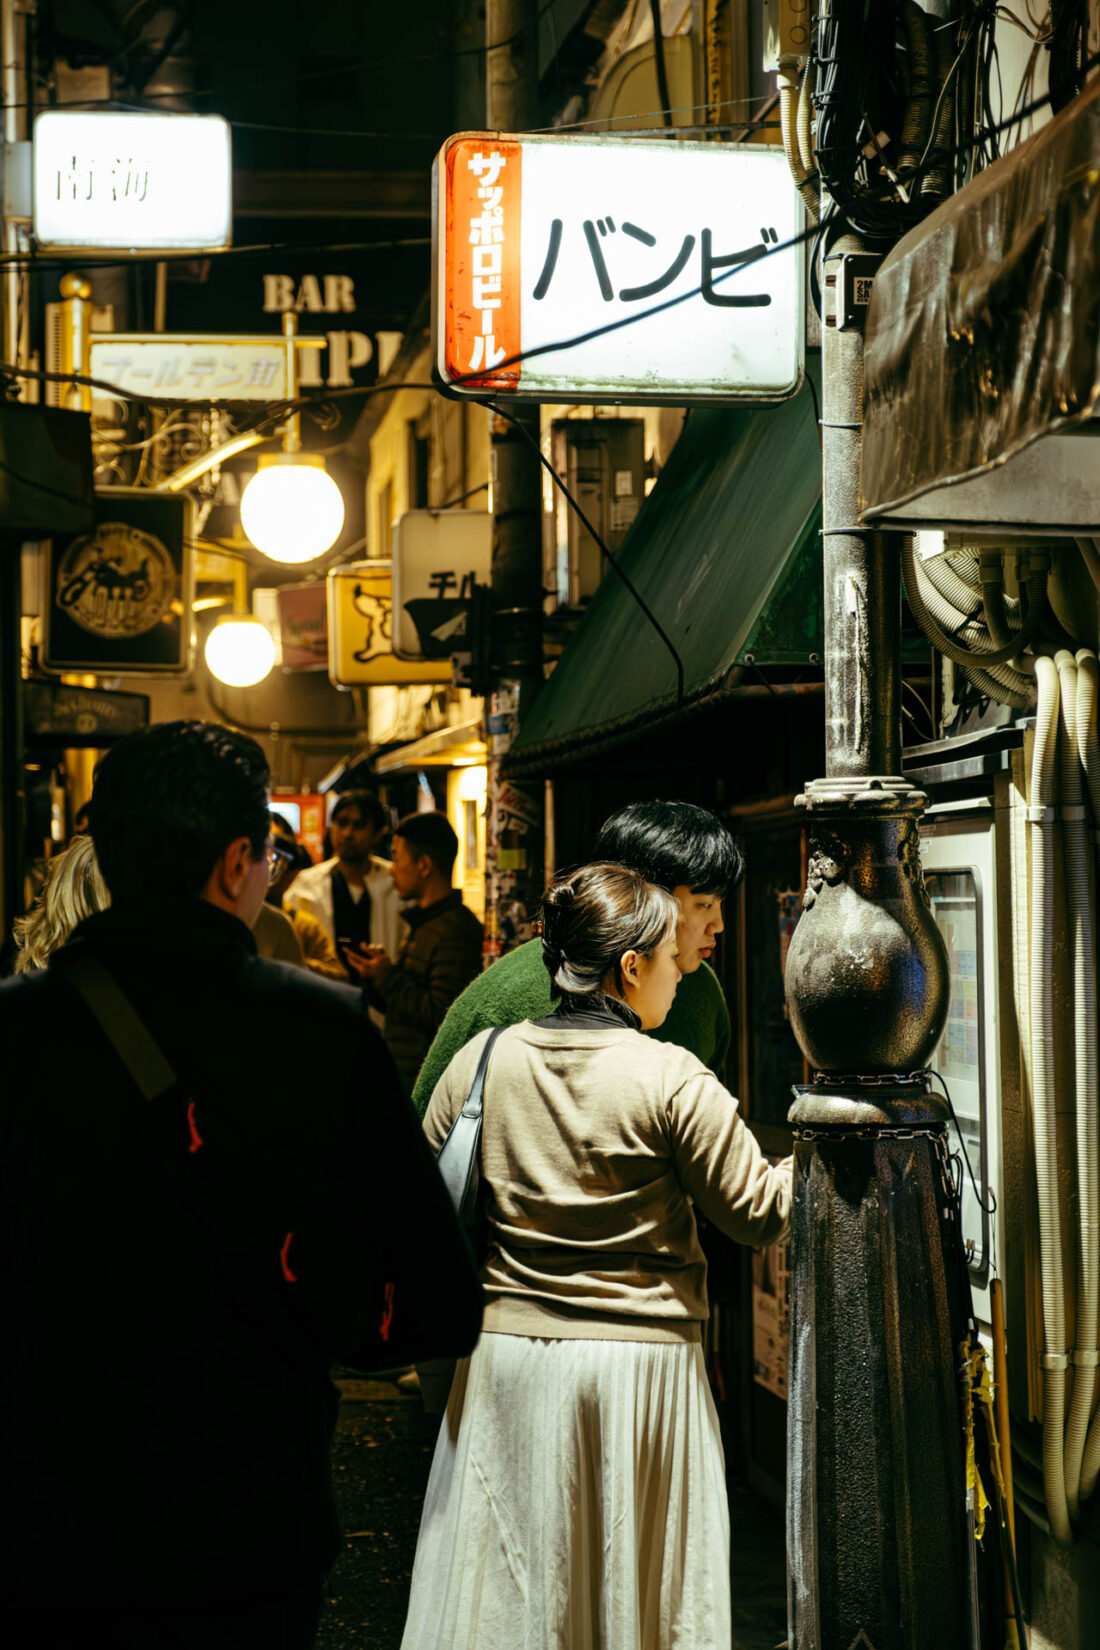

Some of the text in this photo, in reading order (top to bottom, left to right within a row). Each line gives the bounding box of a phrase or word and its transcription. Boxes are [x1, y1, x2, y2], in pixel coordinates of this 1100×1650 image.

[263, 273, 357, 314] BAR
[468, 151, 506, 371] サッポロビール
[532, 215, 779, 308] バンビ
